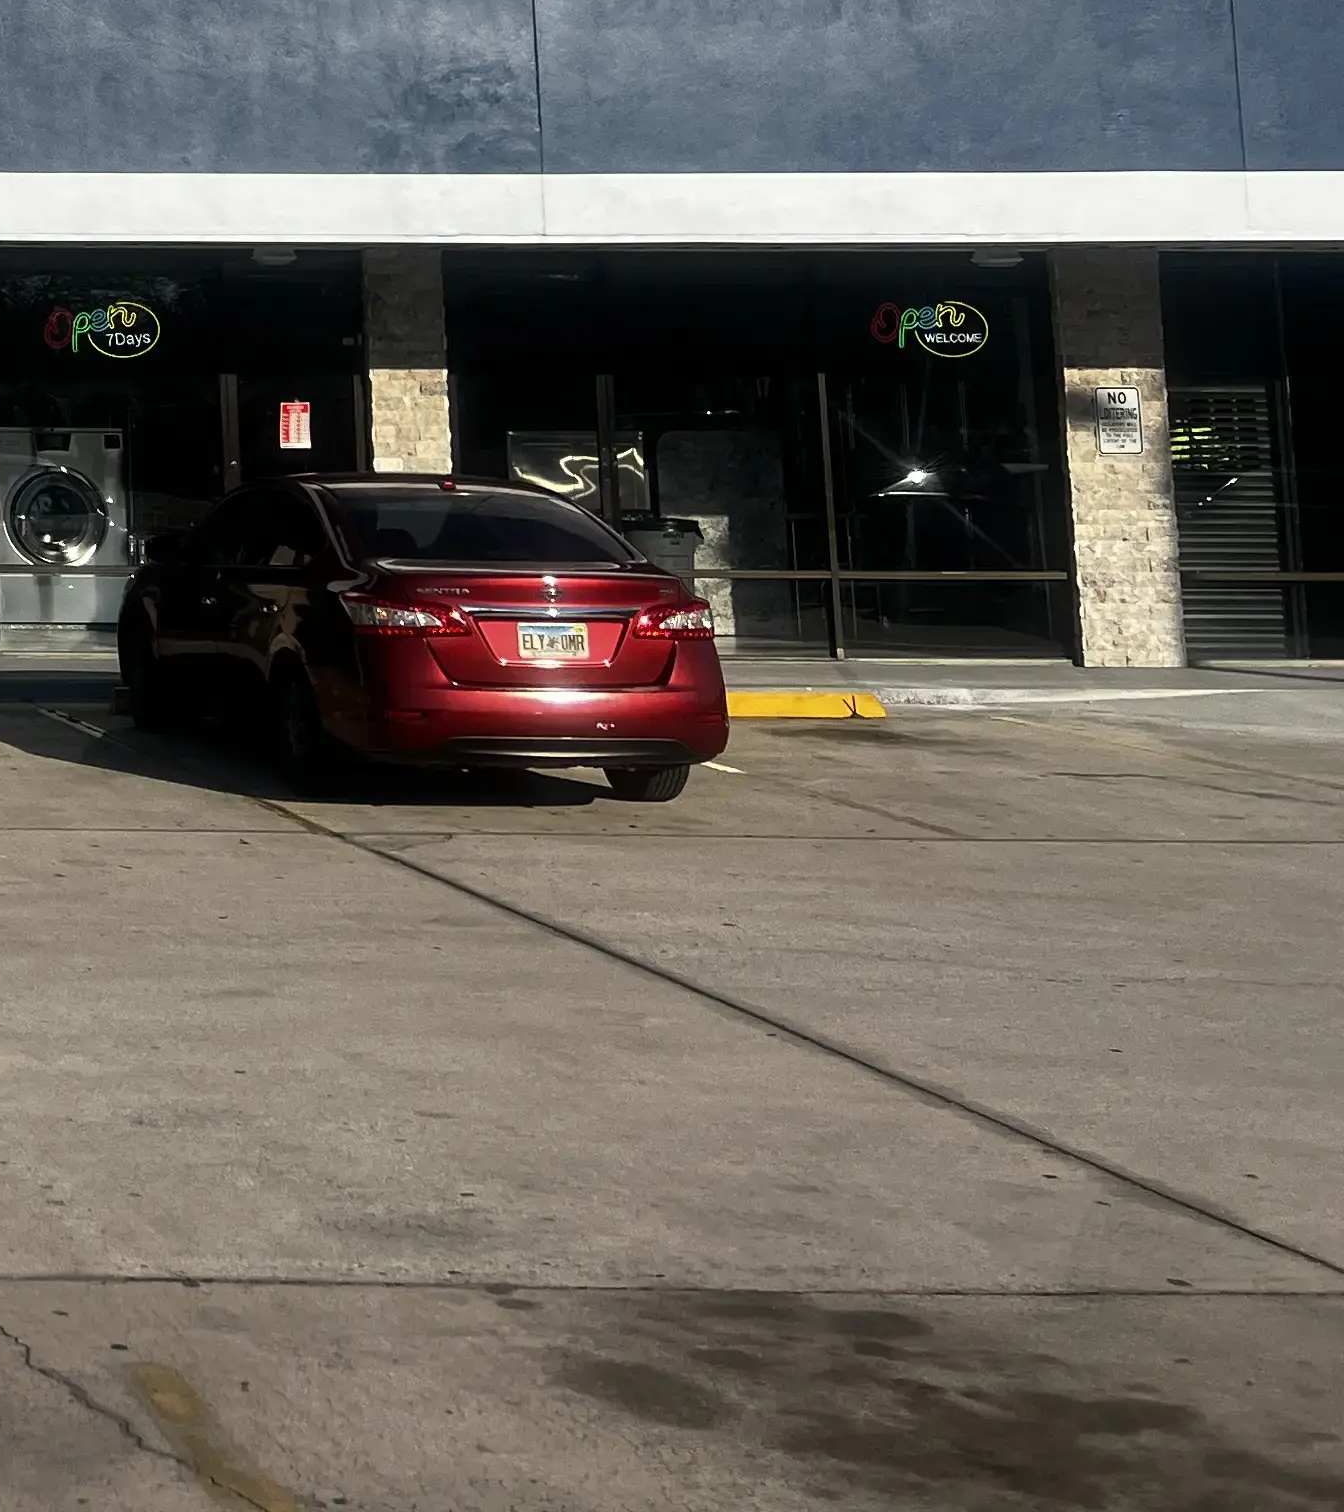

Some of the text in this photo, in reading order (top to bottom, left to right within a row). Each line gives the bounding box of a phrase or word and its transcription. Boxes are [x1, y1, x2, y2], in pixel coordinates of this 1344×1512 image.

[924, 332, 983, 343] WELCOME
[1107, 391, 1127, 404] NO
[1099, 407, 1138, 419] LOITERING
